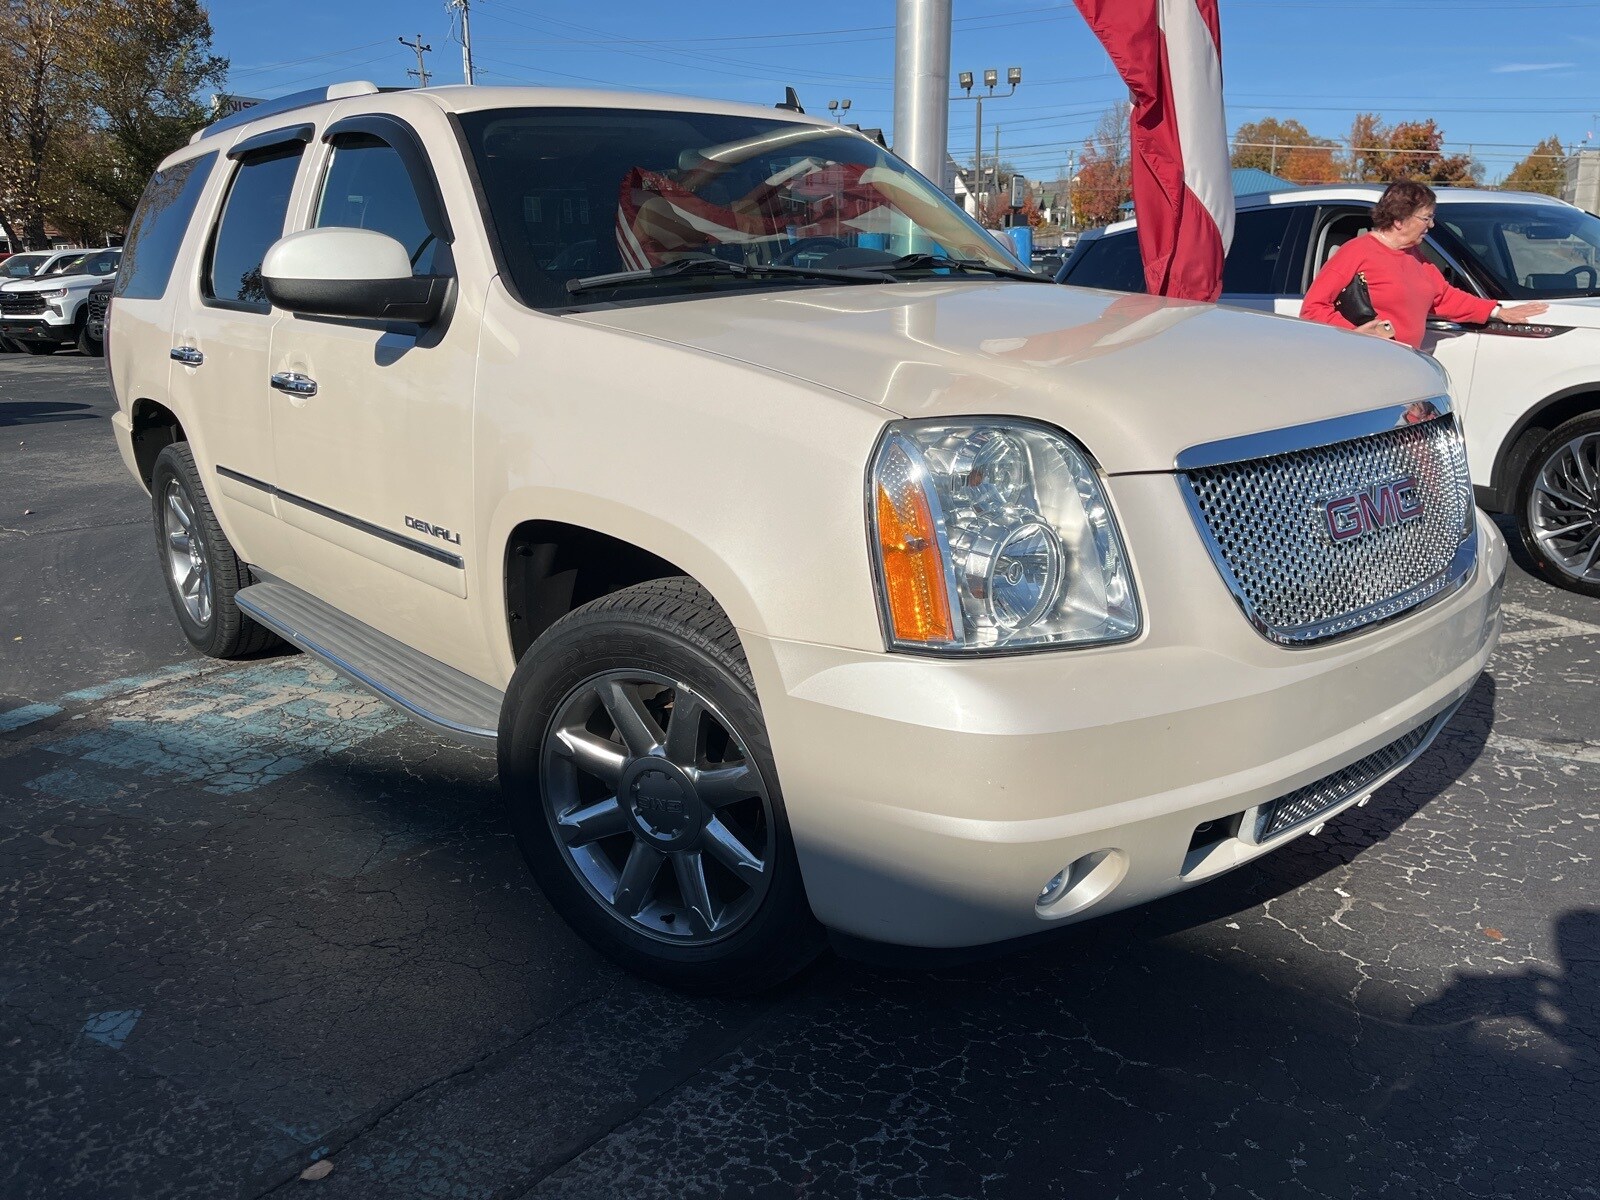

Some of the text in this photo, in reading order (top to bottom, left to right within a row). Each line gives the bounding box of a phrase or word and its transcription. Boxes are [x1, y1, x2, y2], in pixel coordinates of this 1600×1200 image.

[227, 100, 258, 112] NIS
[1326, 475, 1424, 541] GMC
[404, 514, 461, 545] DENALI
